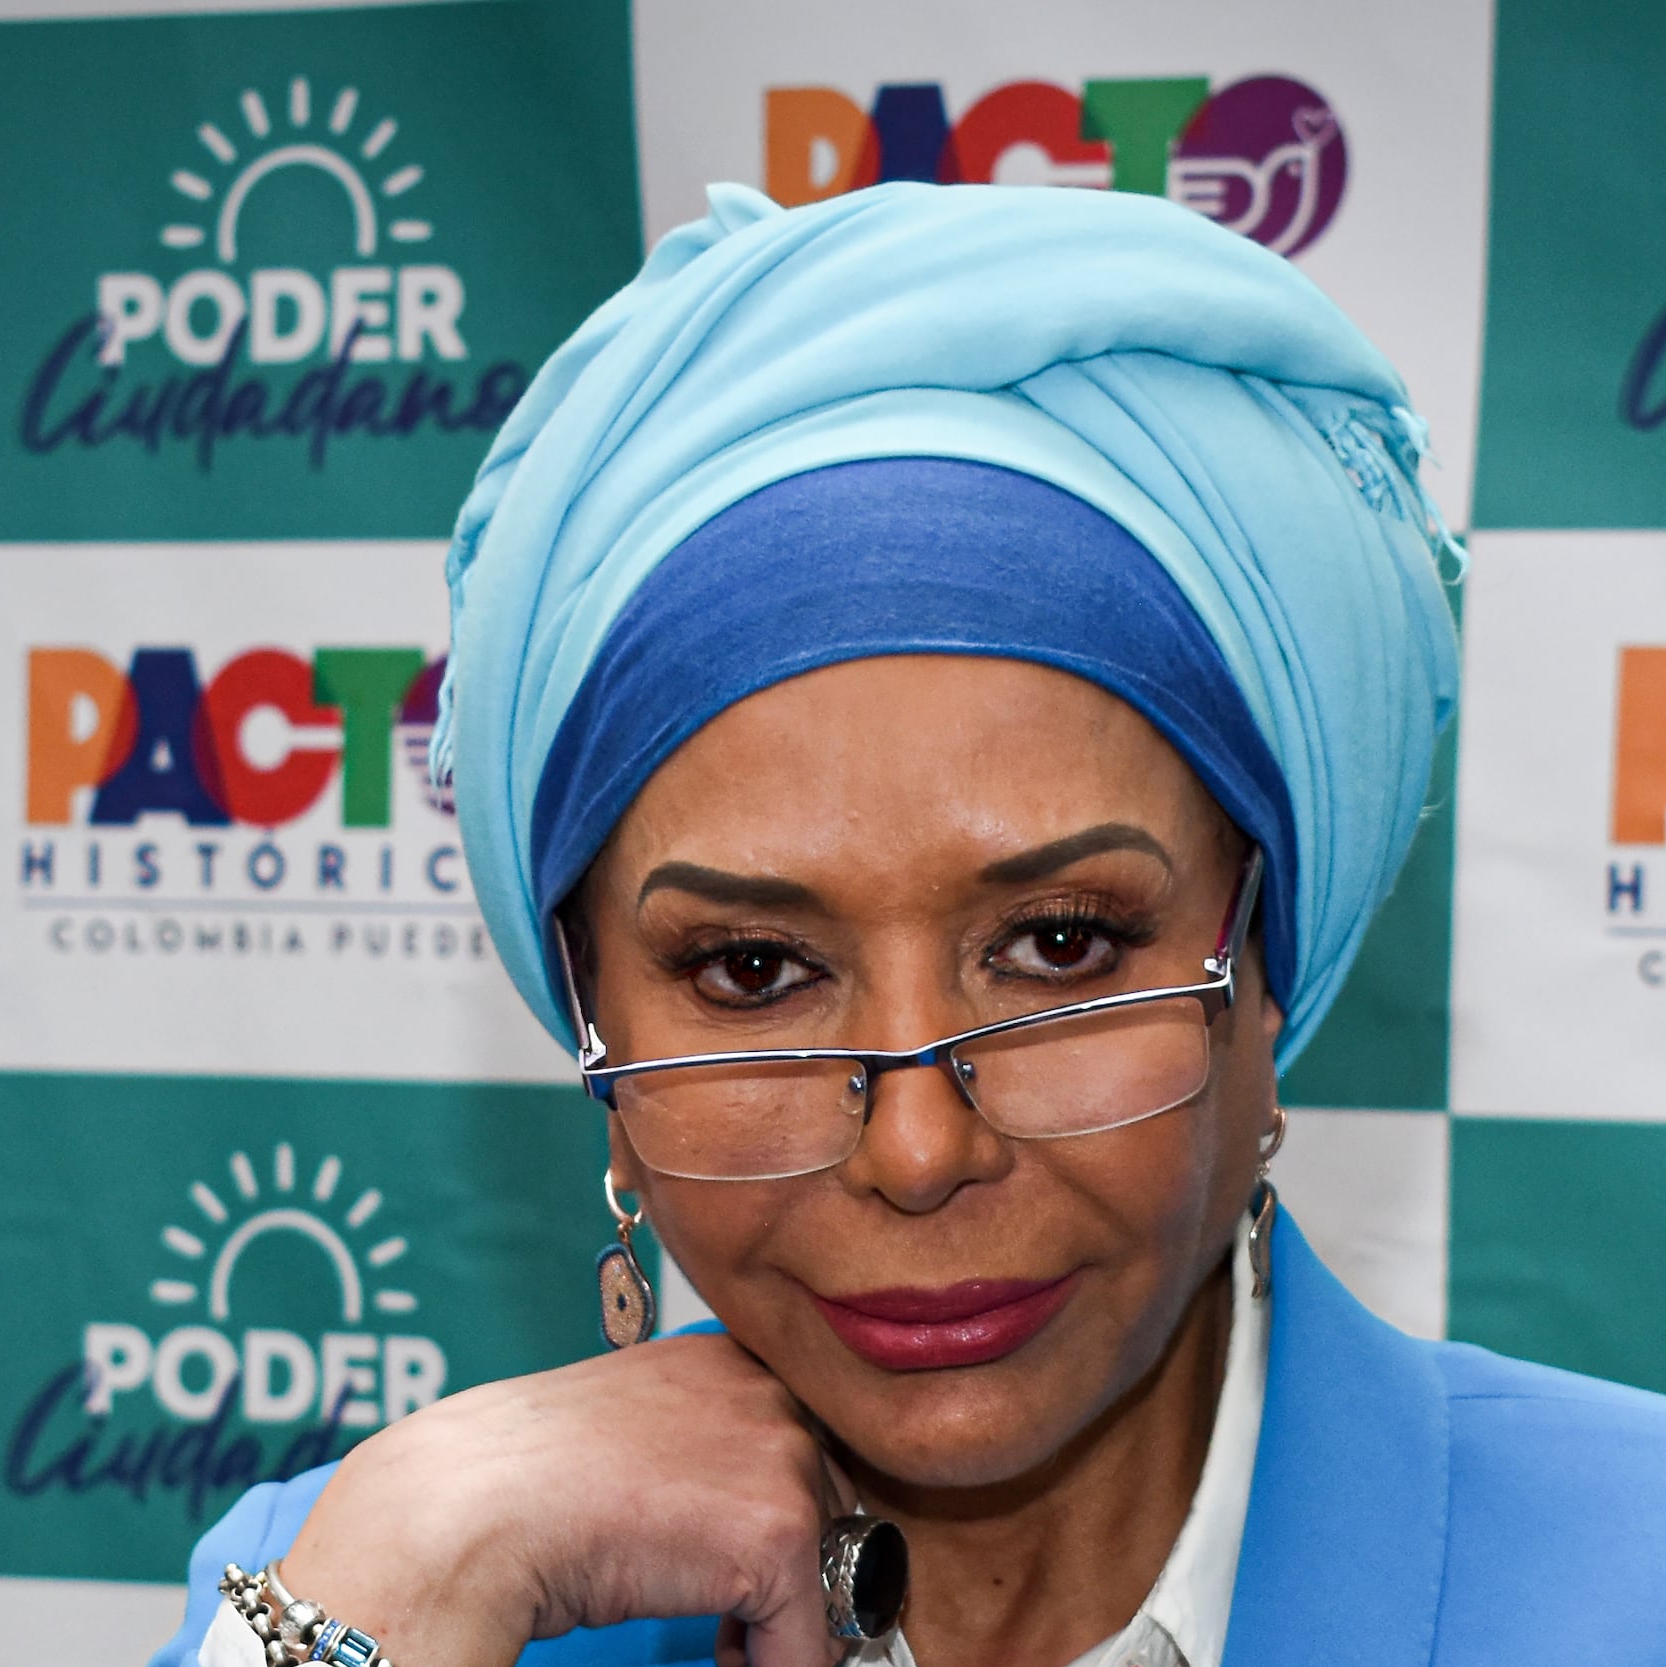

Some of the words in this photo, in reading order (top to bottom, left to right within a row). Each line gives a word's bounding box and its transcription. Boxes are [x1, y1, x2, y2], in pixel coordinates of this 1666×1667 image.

[96, 265, 468, 366] PODER
[20, 310, 530, 474] Ciudadano
[21, 830, 461, 892] HISTÓRIC
[50, 920, 306, 956] COLOMBIA
[330, 923, 490, 958] PUEDE
[84, 1323, 446, 1426] PODER
